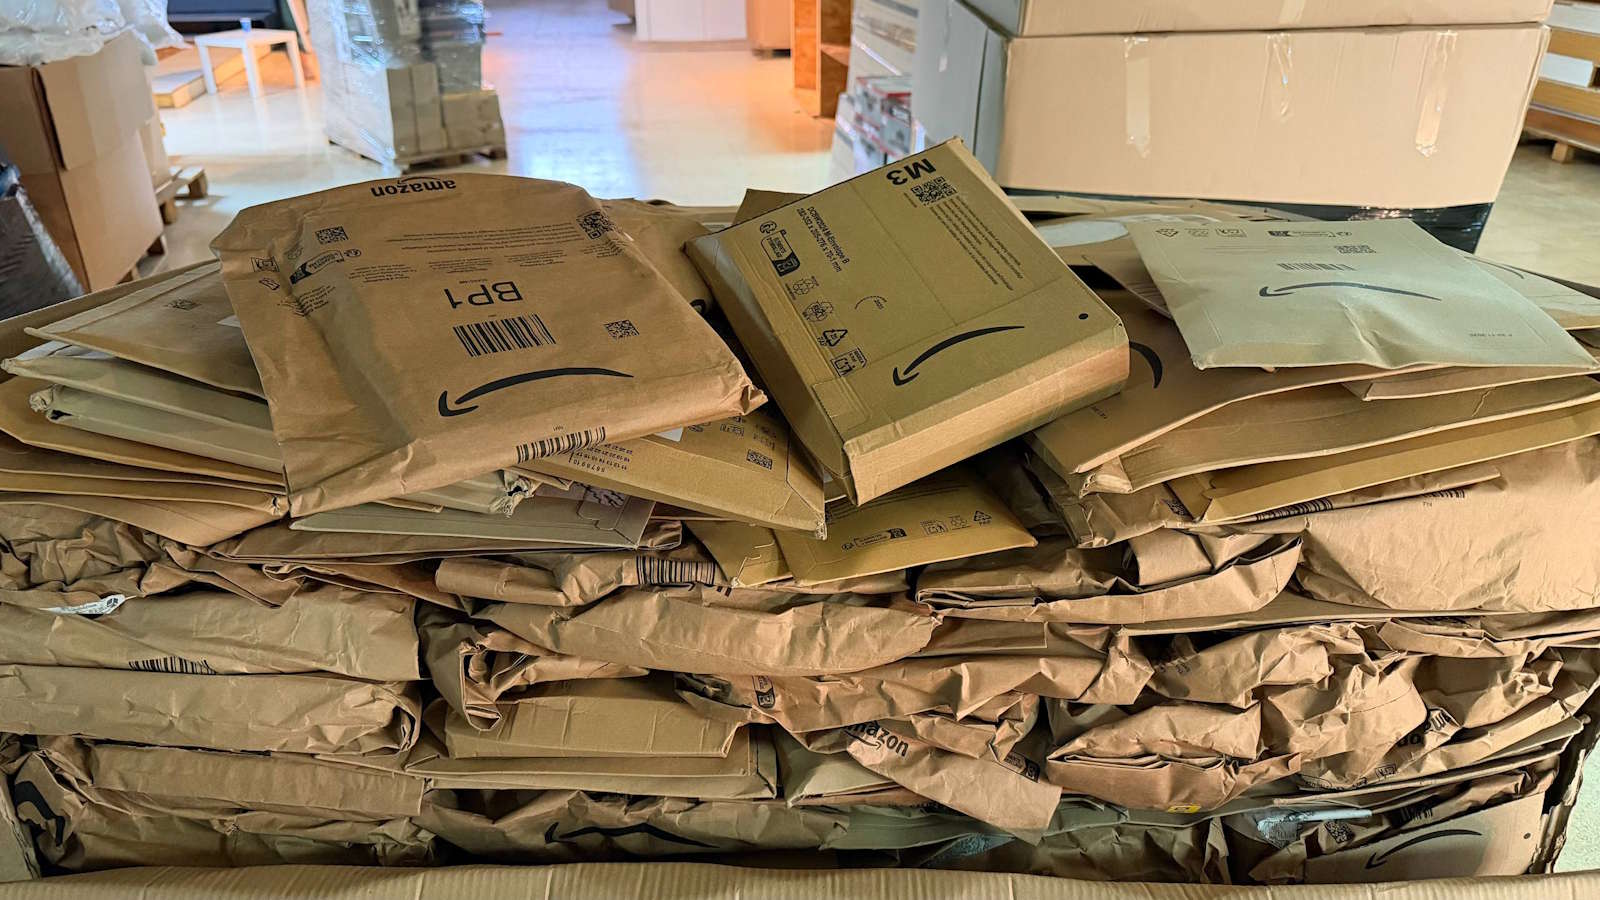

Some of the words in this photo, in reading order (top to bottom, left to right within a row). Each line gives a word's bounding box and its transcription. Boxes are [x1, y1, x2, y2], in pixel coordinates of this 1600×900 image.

[886, 158, 936, 185] M3
[370, 179, 457, 197] amazon
[444, 281, 523, 309] BP1
